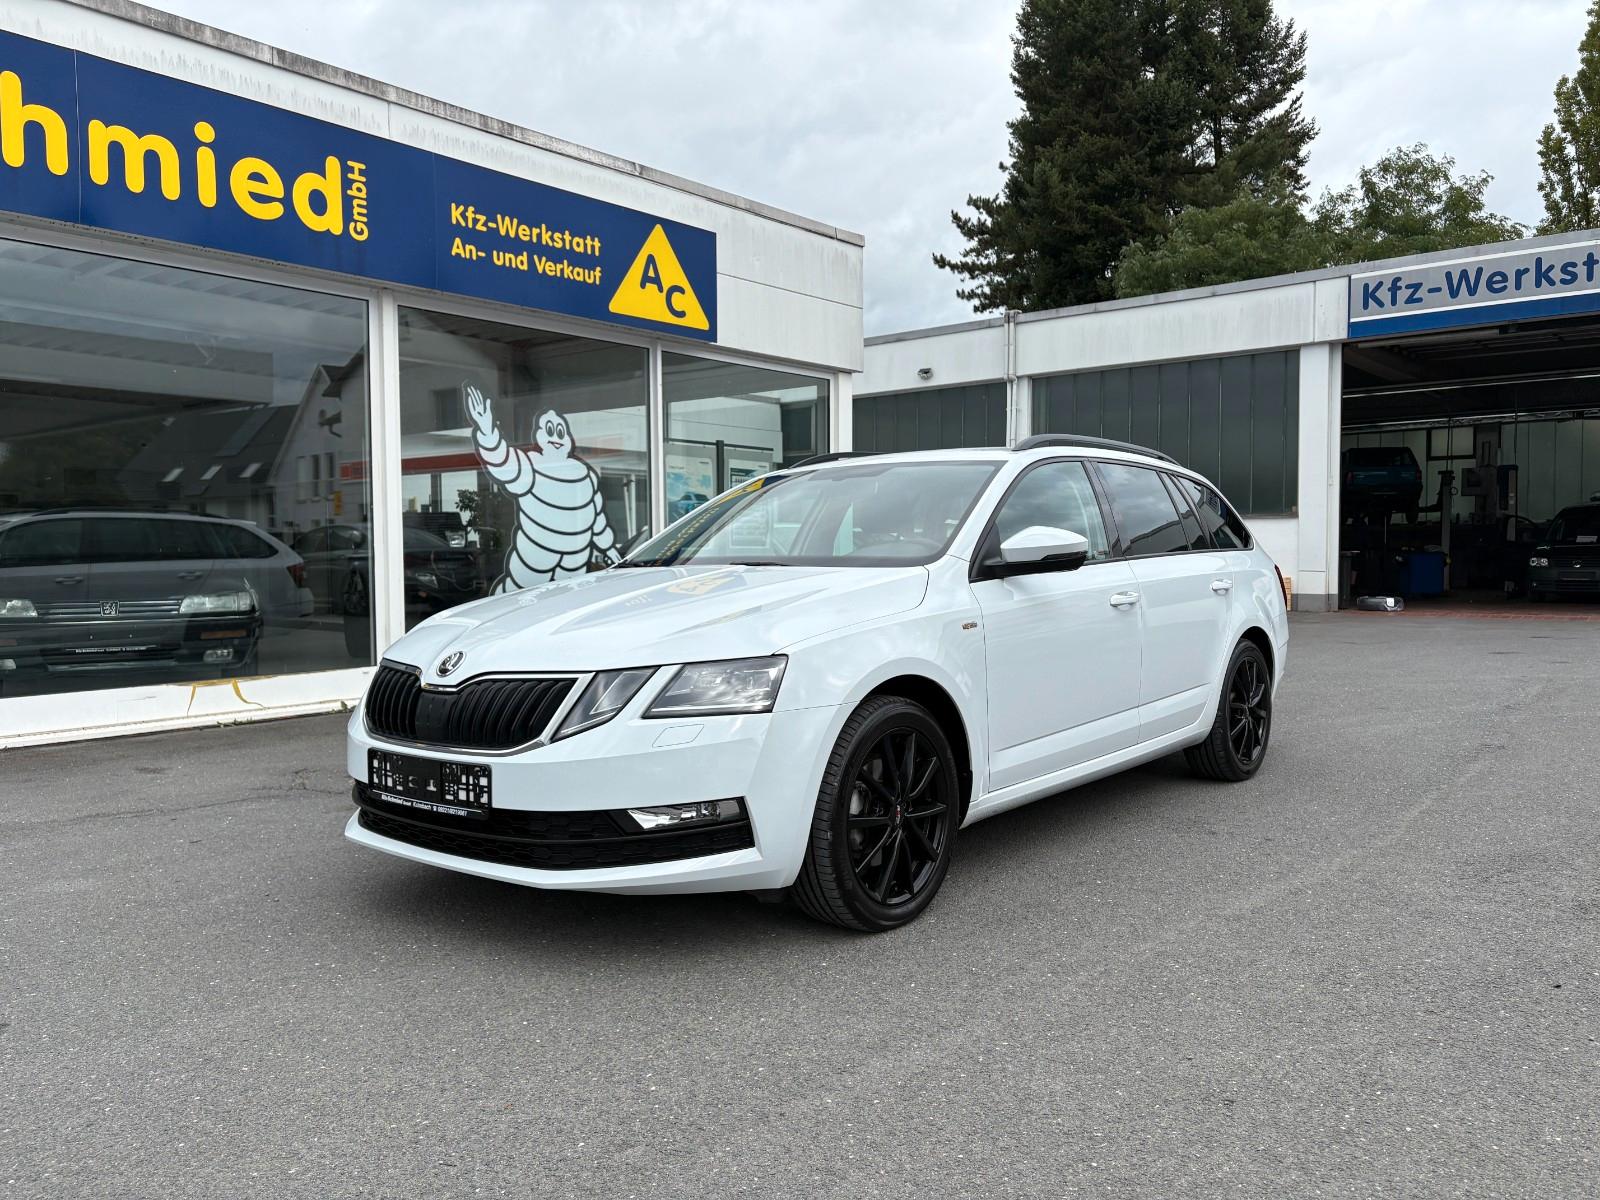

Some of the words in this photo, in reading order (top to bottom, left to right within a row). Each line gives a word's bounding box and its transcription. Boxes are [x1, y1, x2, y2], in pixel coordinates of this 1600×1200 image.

[0, 70, 344, 236] hmied
[347, 160, 369, 241] GmbH
[451, 203, 601, 256] Kfz-Werkstatt
[451, 237, 487, 261] An-
[492, 248, 528, 271] und
[534, 255, 602, 285] Verkauf
[1362, 251, 1600, 311] Kfz-Werkst
